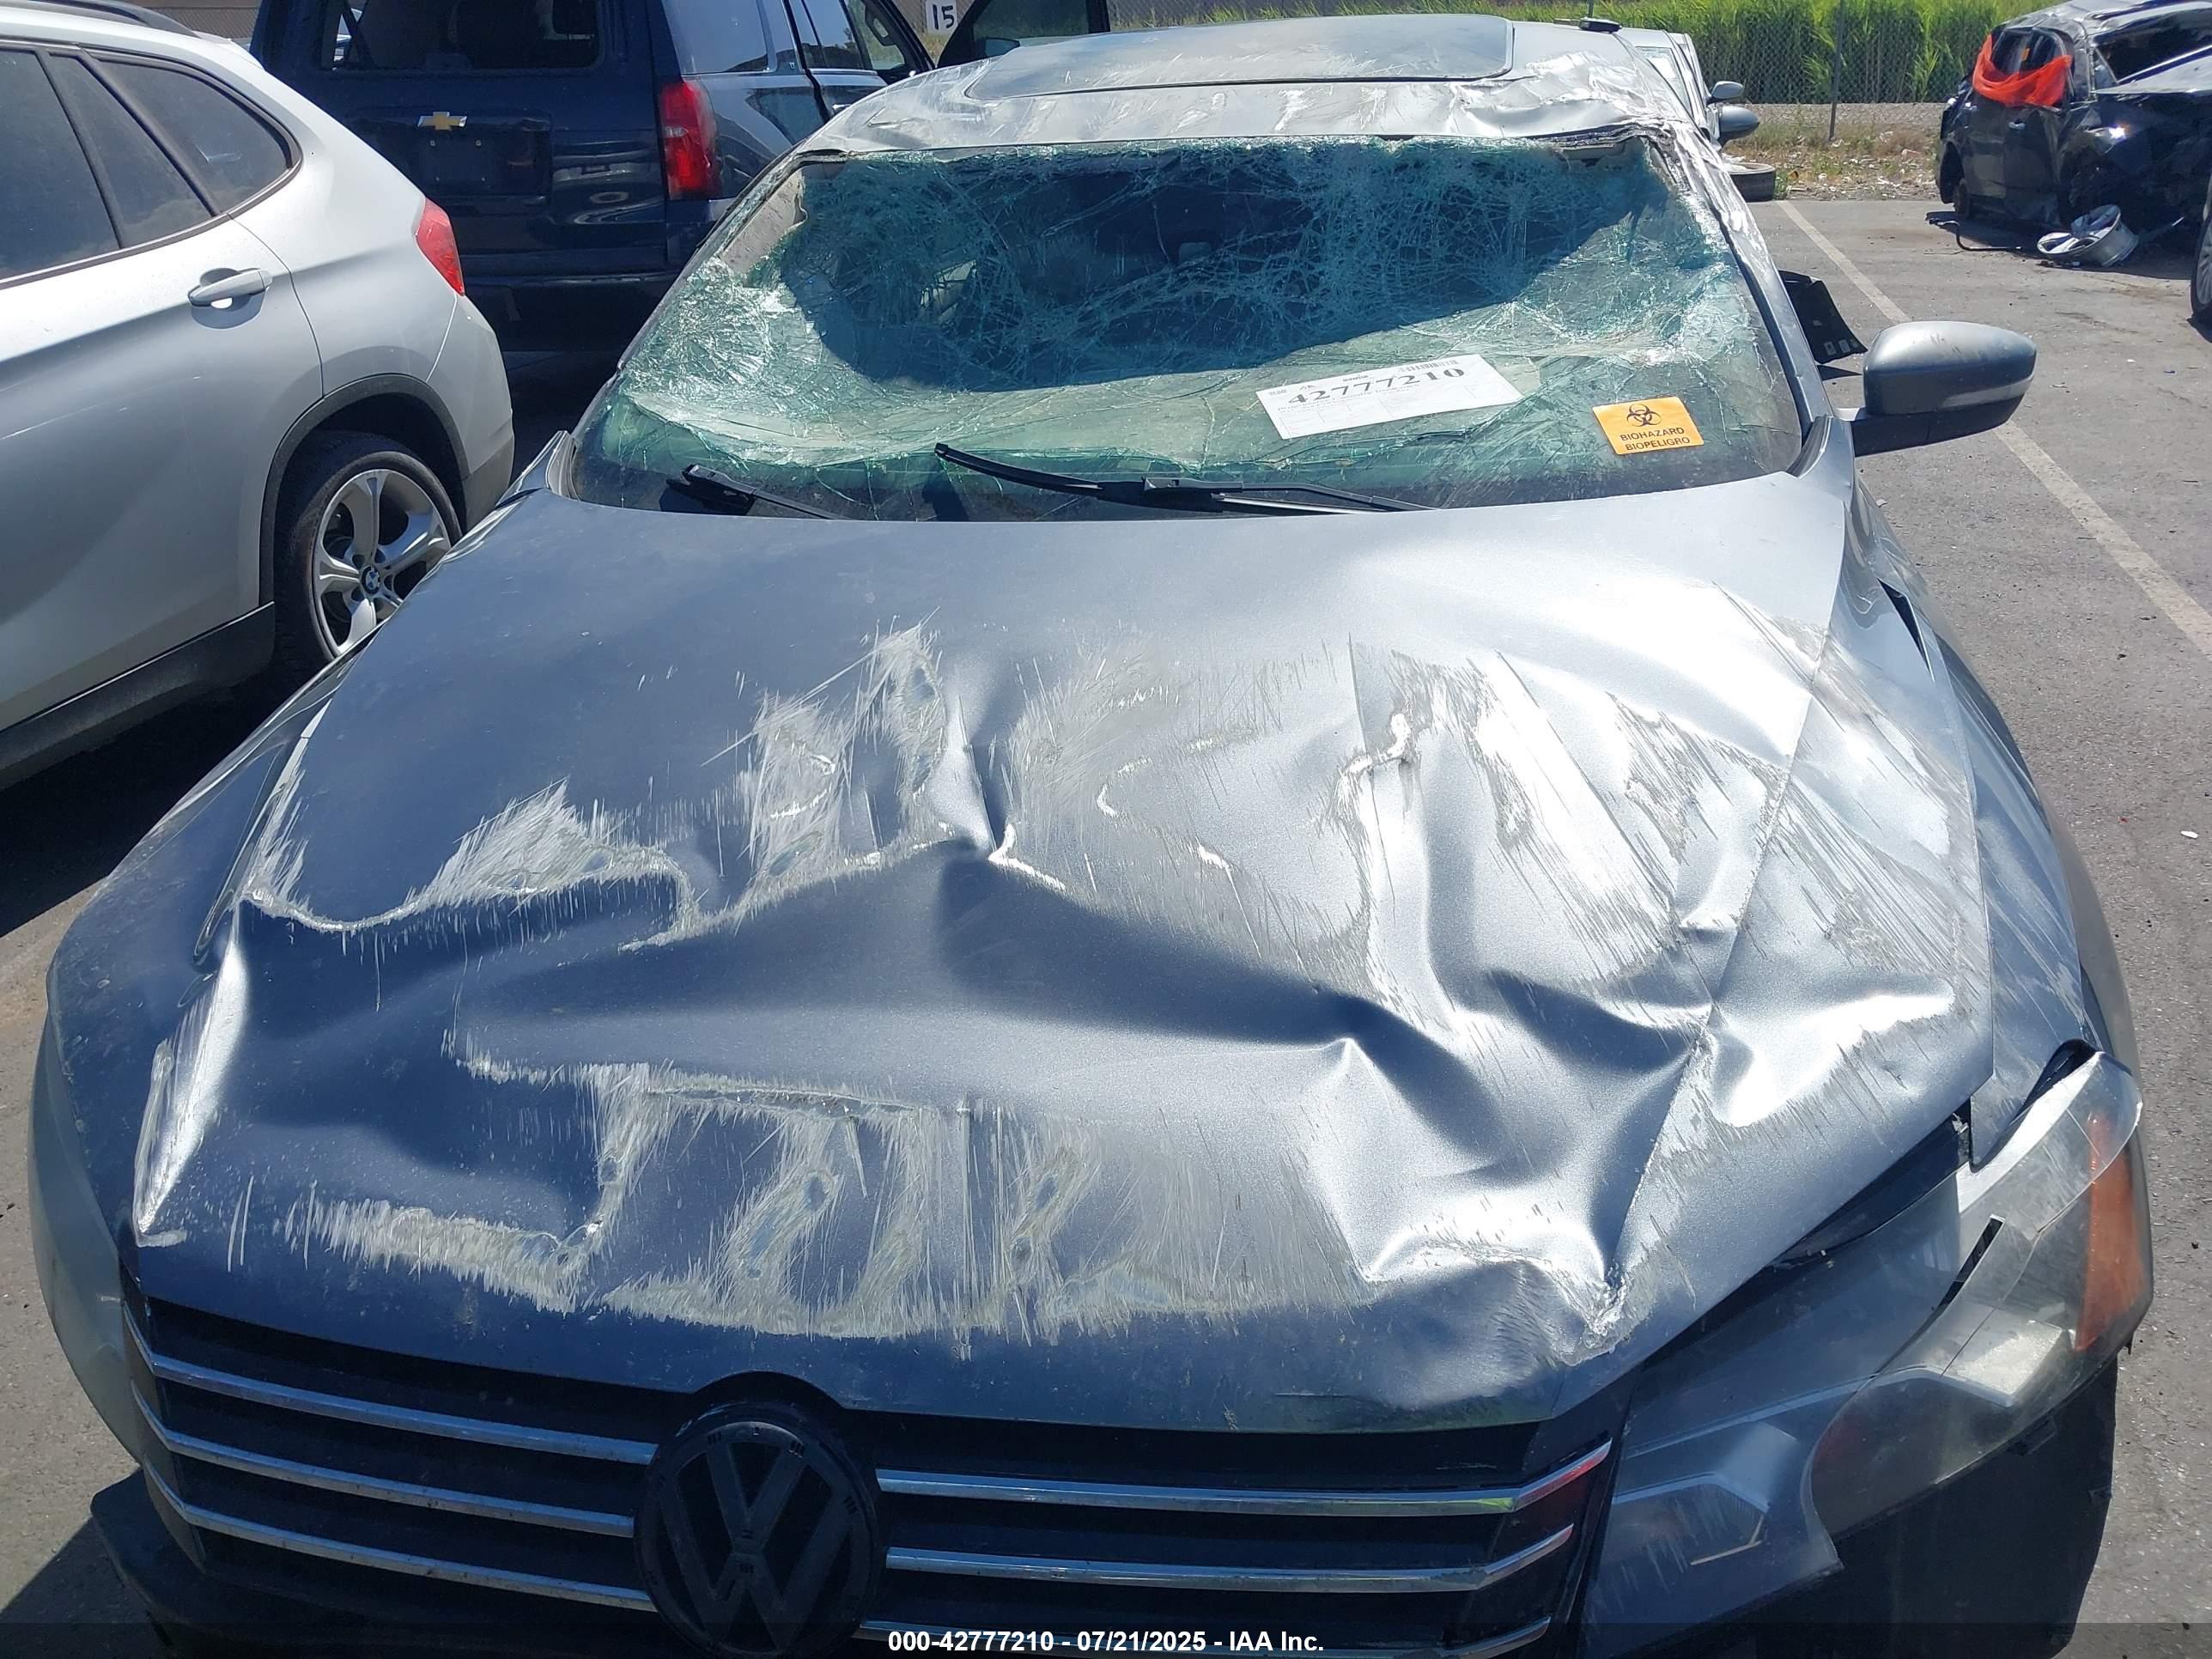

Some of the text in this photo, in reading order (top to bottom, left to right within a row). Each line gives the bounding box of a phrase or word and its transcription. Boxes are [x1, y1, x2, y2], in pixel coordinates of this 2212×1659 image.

[933, 4, 954, 30] 15
[1288, 368, 1465, 404] 42777210
[1620, 427, 1685, 441] BIOHAZARD
[1626, 436, 1690, 451] BIOPELIGRO
